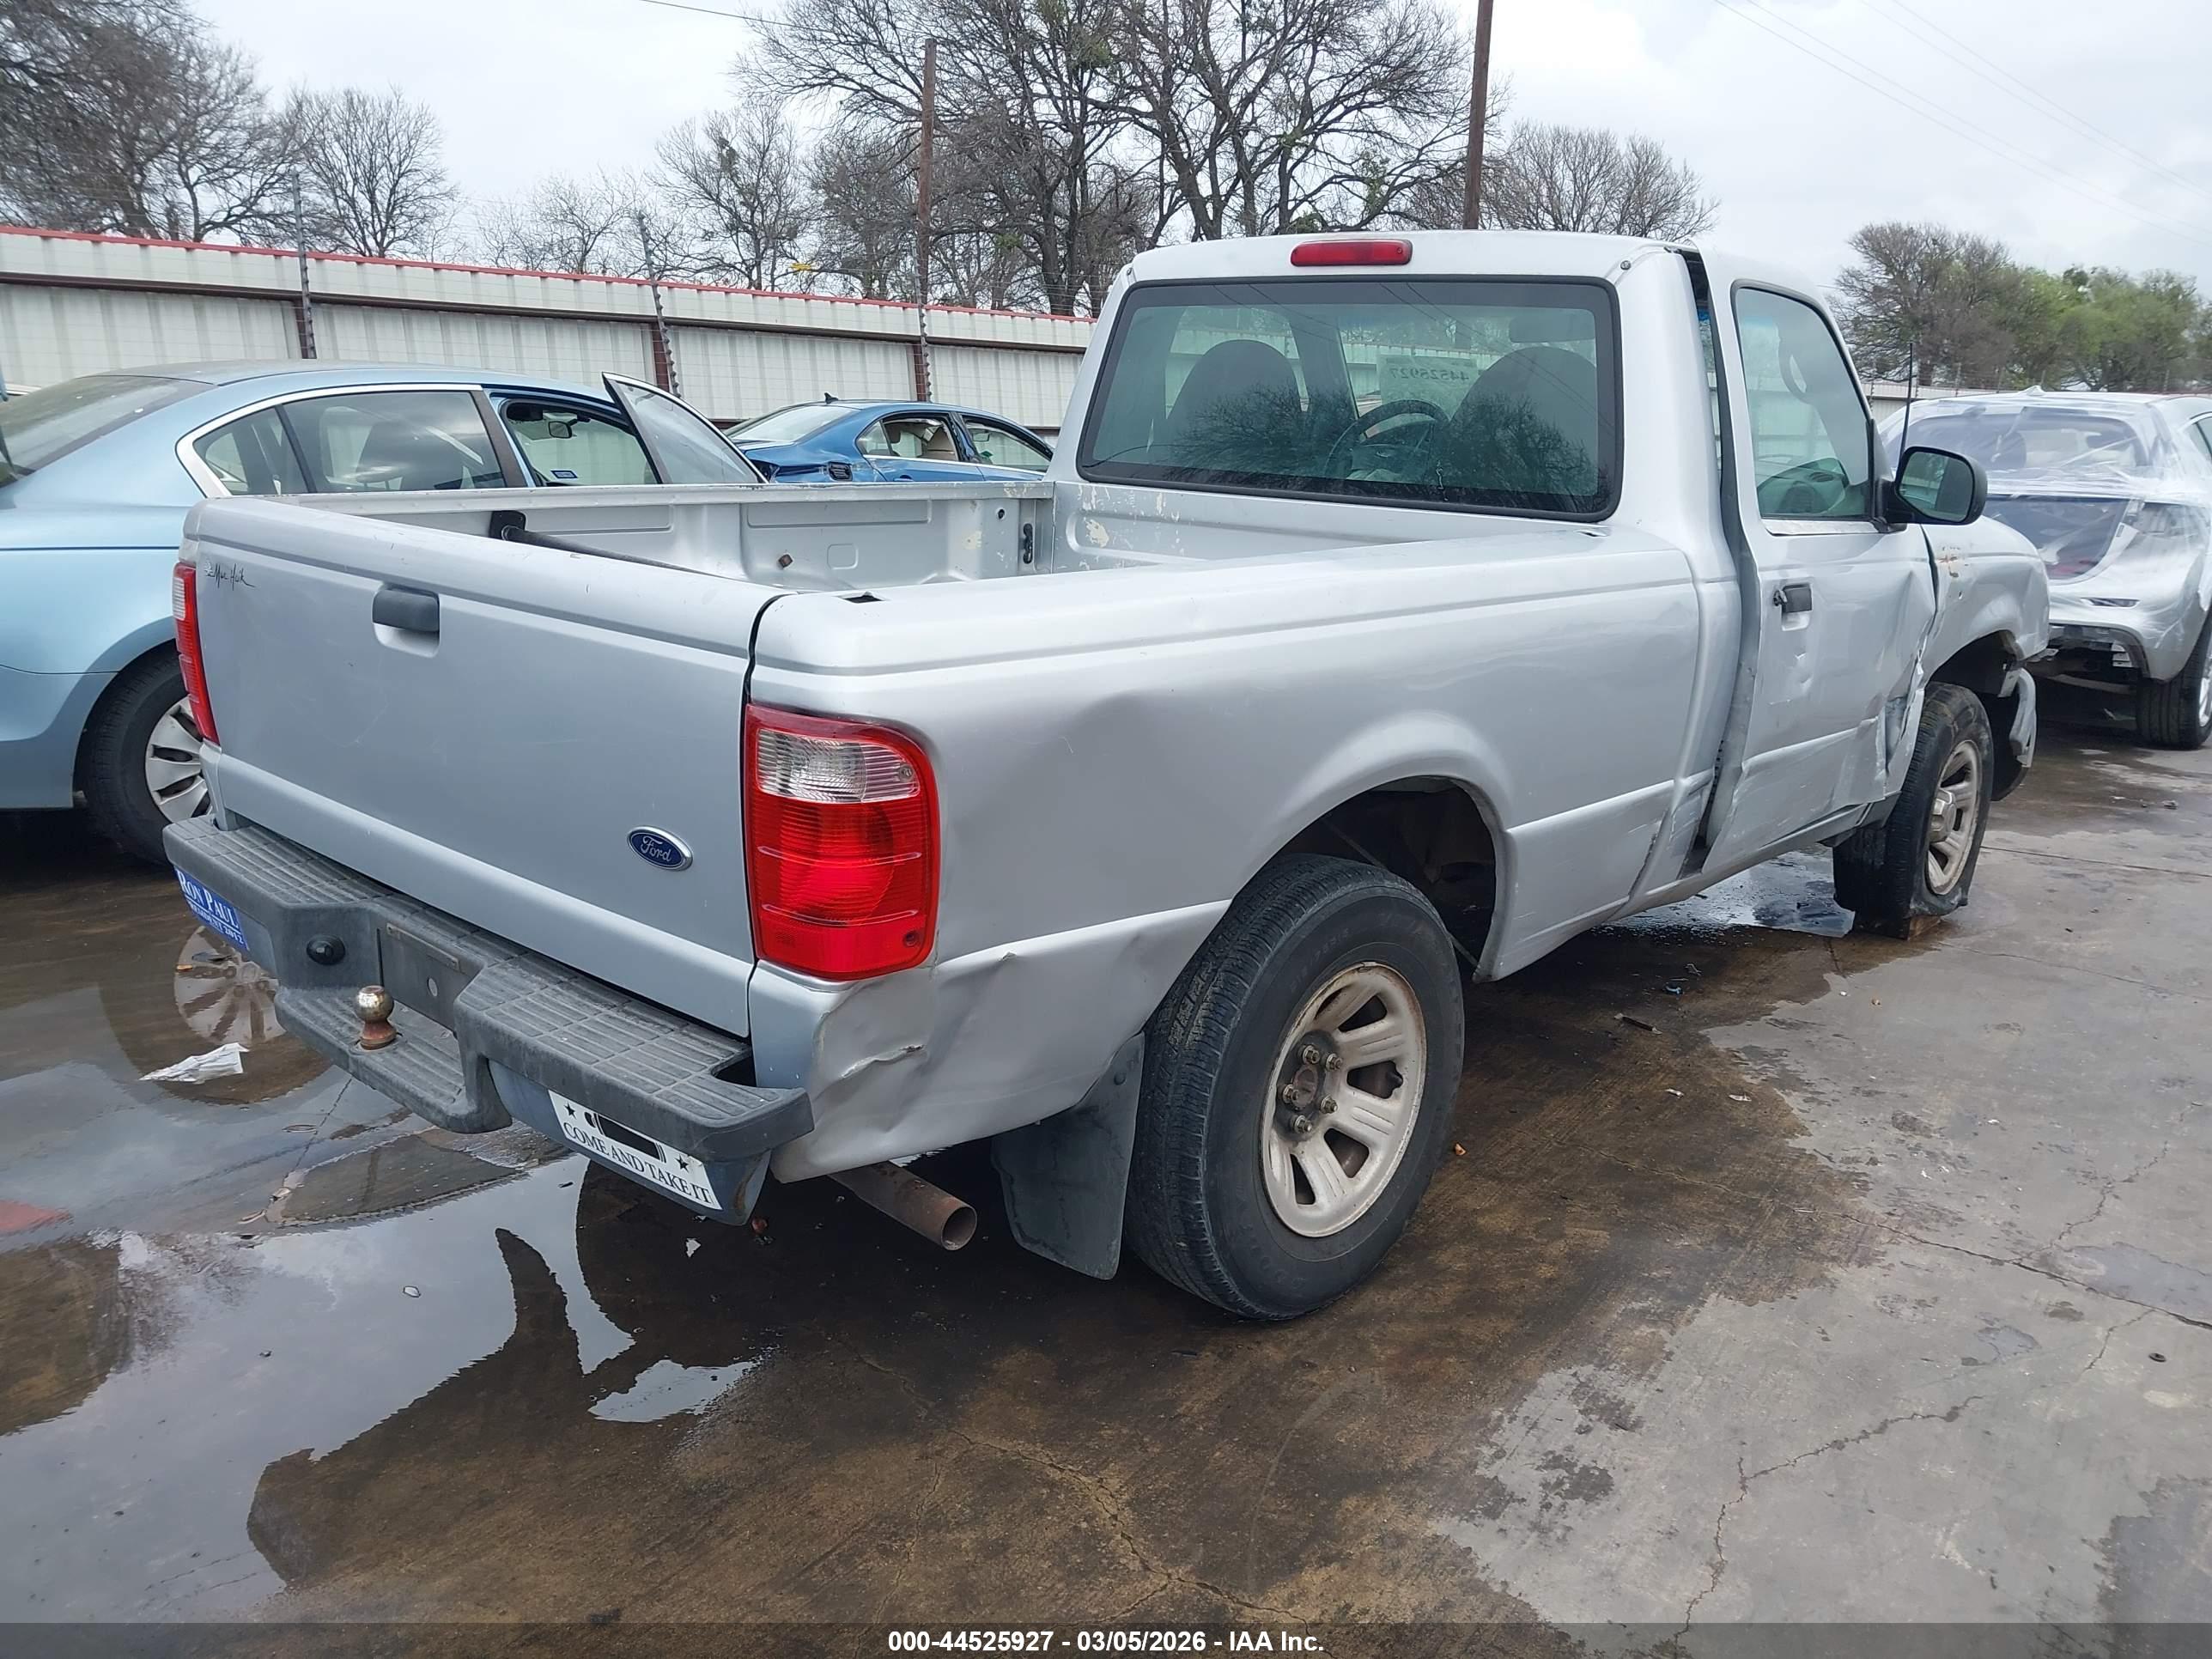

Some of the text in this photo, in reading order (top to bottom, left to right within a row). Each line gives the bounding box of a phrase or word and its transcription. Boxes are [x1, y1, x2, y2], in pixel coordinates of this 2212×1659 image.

[640, 836, 672, 862] Ford
[176, 869, 239, 929] RON PAUL
[223, 927, 245, 945] 2012
[563, 1121, 712, 1204] COME AND TAKE IT
